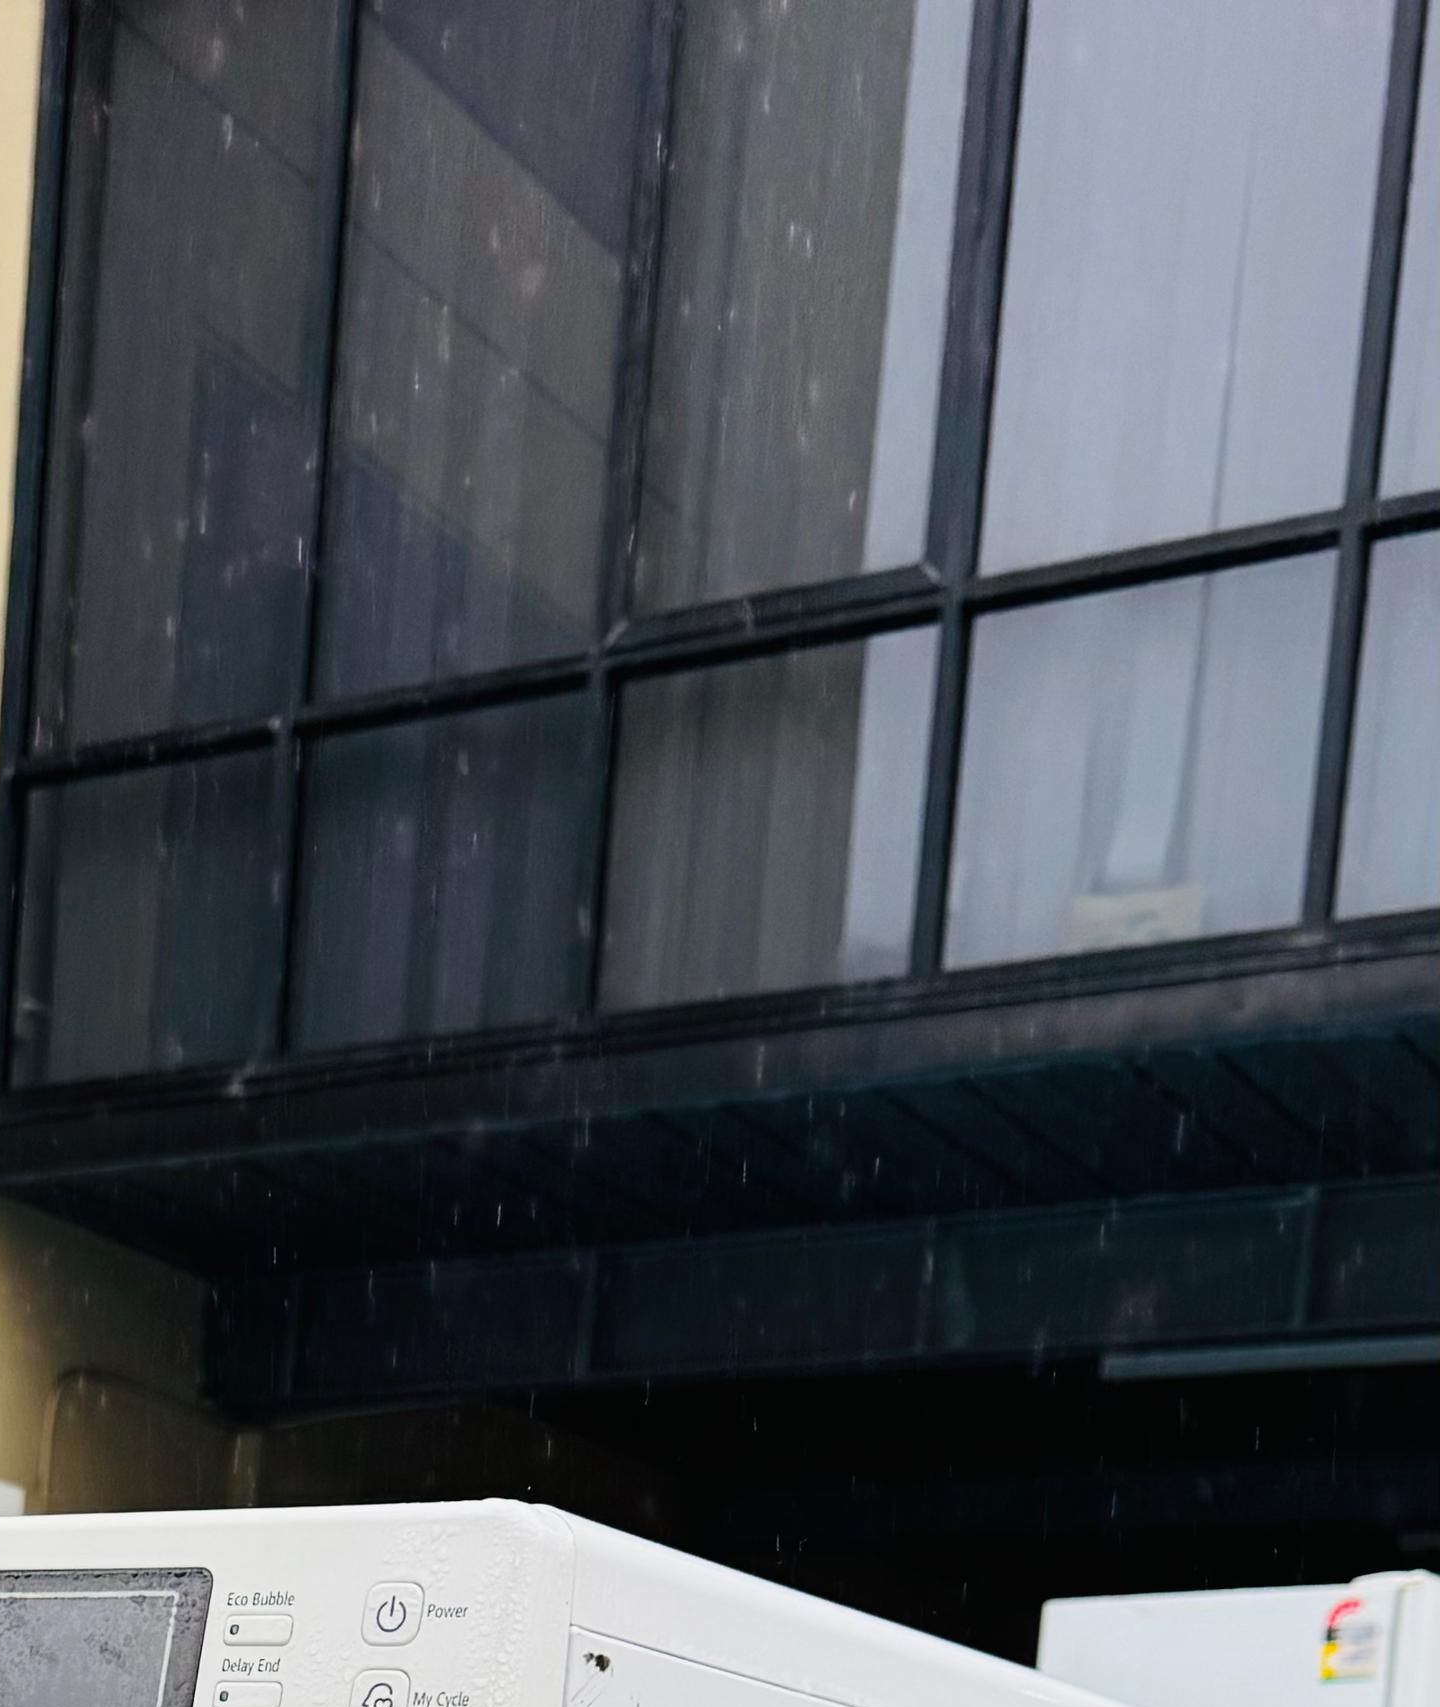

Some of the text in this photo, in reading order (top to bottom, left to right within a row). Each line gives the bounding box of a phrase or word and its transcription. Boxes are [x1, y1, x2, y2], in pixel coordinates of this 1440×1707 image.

[226, 1590, 296, 1607] Eco Bubble
[426, 1603, 469, 1619] Power
[221, 1657, 281, 1677] Delay End
